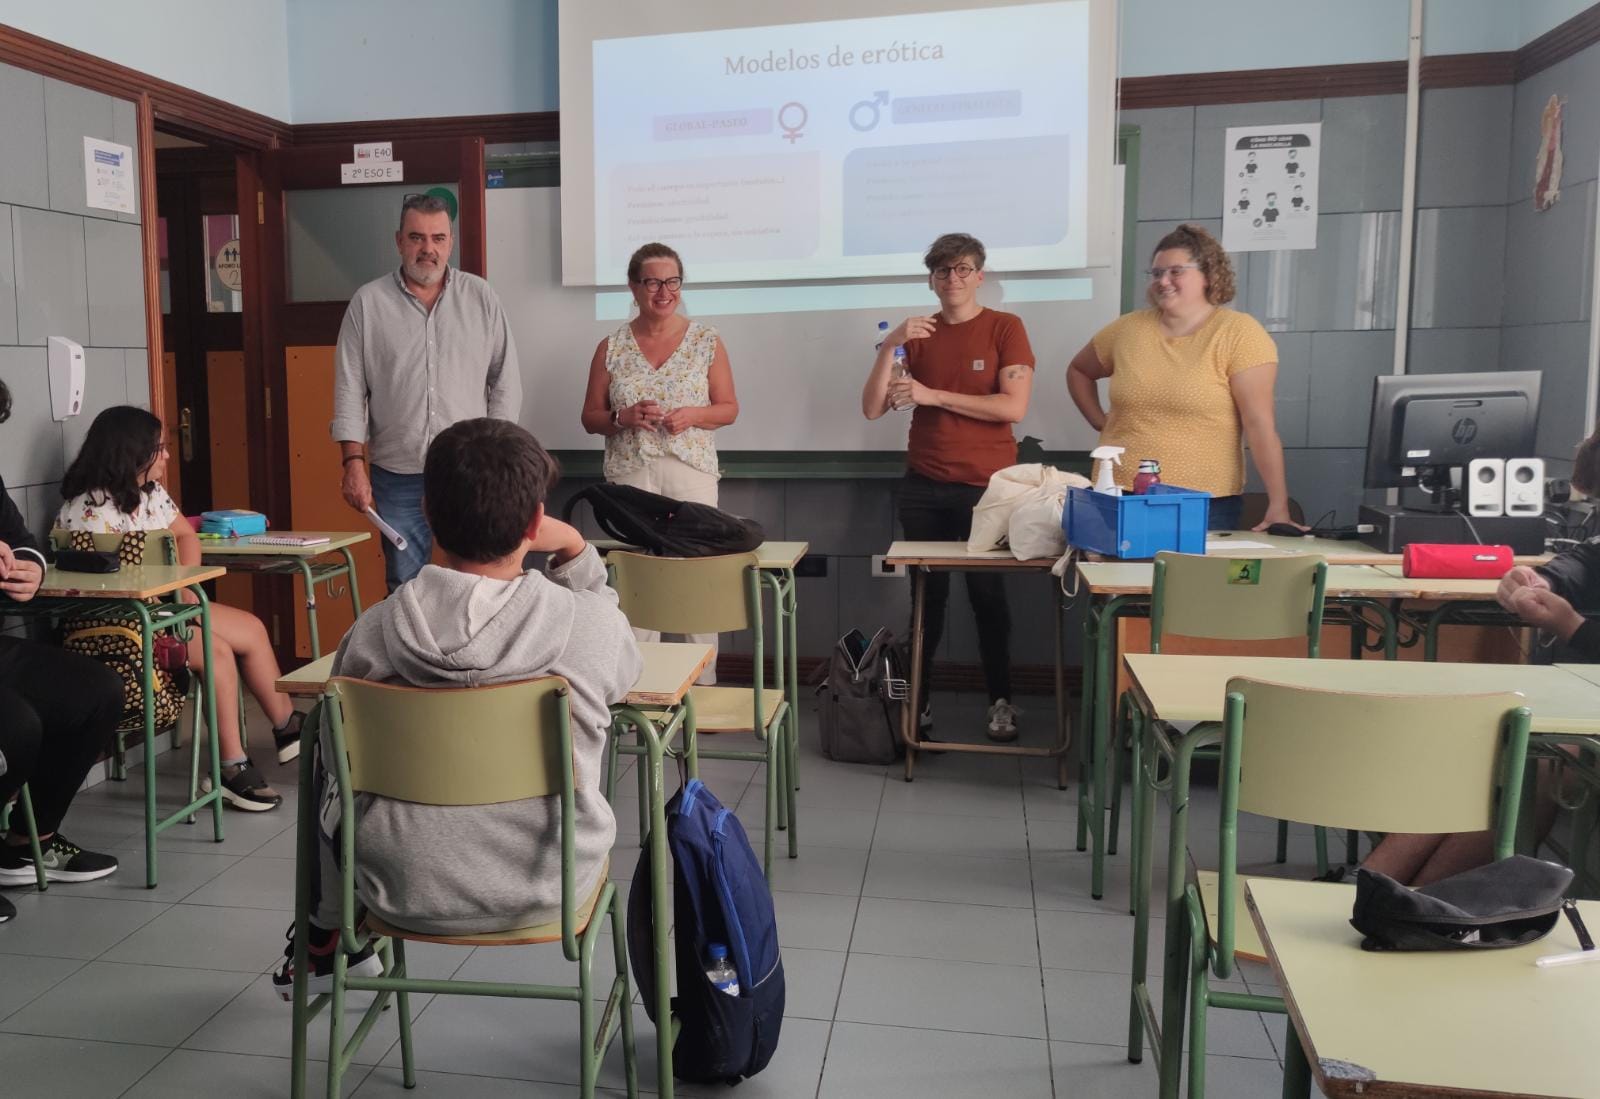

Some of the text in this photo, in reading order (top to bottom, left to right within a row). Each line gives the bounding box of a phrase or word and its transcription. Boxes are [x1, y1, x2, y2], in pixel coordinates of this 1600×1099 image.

[723, 40, 944, 76] Modelos de erótica
[374, 147, 391, 158] E40
[364, 168, 384, 178] ESO
[386, 167, 393, 177] E
[1452, 418, 1478, 445] hp
